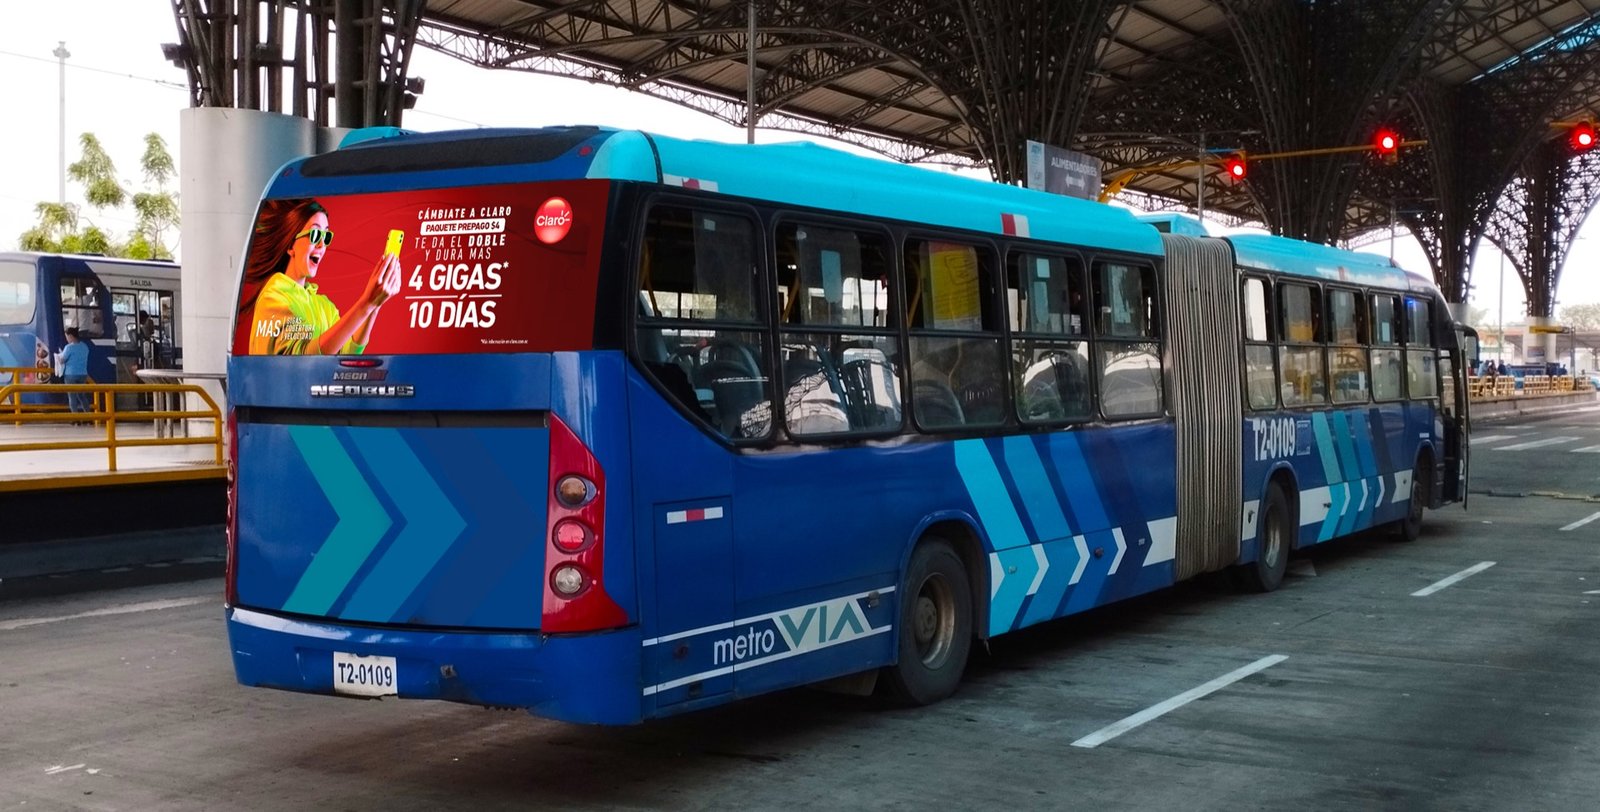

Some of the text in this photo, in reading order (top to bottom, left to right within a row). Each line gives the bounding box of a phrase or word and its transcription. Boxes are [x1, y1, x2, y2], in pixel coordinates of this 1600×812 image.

[1050, 156, 1097, 177] ALIMENTADORES
[417, 206, 512, 220] CÁMBIATE A CLARO
[425, 221, 500, 232] PAQUETE PREPAGO $4
[415, 234, 507, 249] TE DA EL DOBLE
[424, 250, 431, 261] Y
[435, 248, 463, 261] DURA
[130, 279, 153, 287] SALIDA
[408, 264, 423, 291] 4
[409, 293, 497, 329] 10 DÍAS
[255, 314, 282, 338] MÁS
[310, 384, 414, 397] NEOBUS
[1252, 417, 1296, 461] T2-0109
[338, 662, 392, 687] T2-0109
